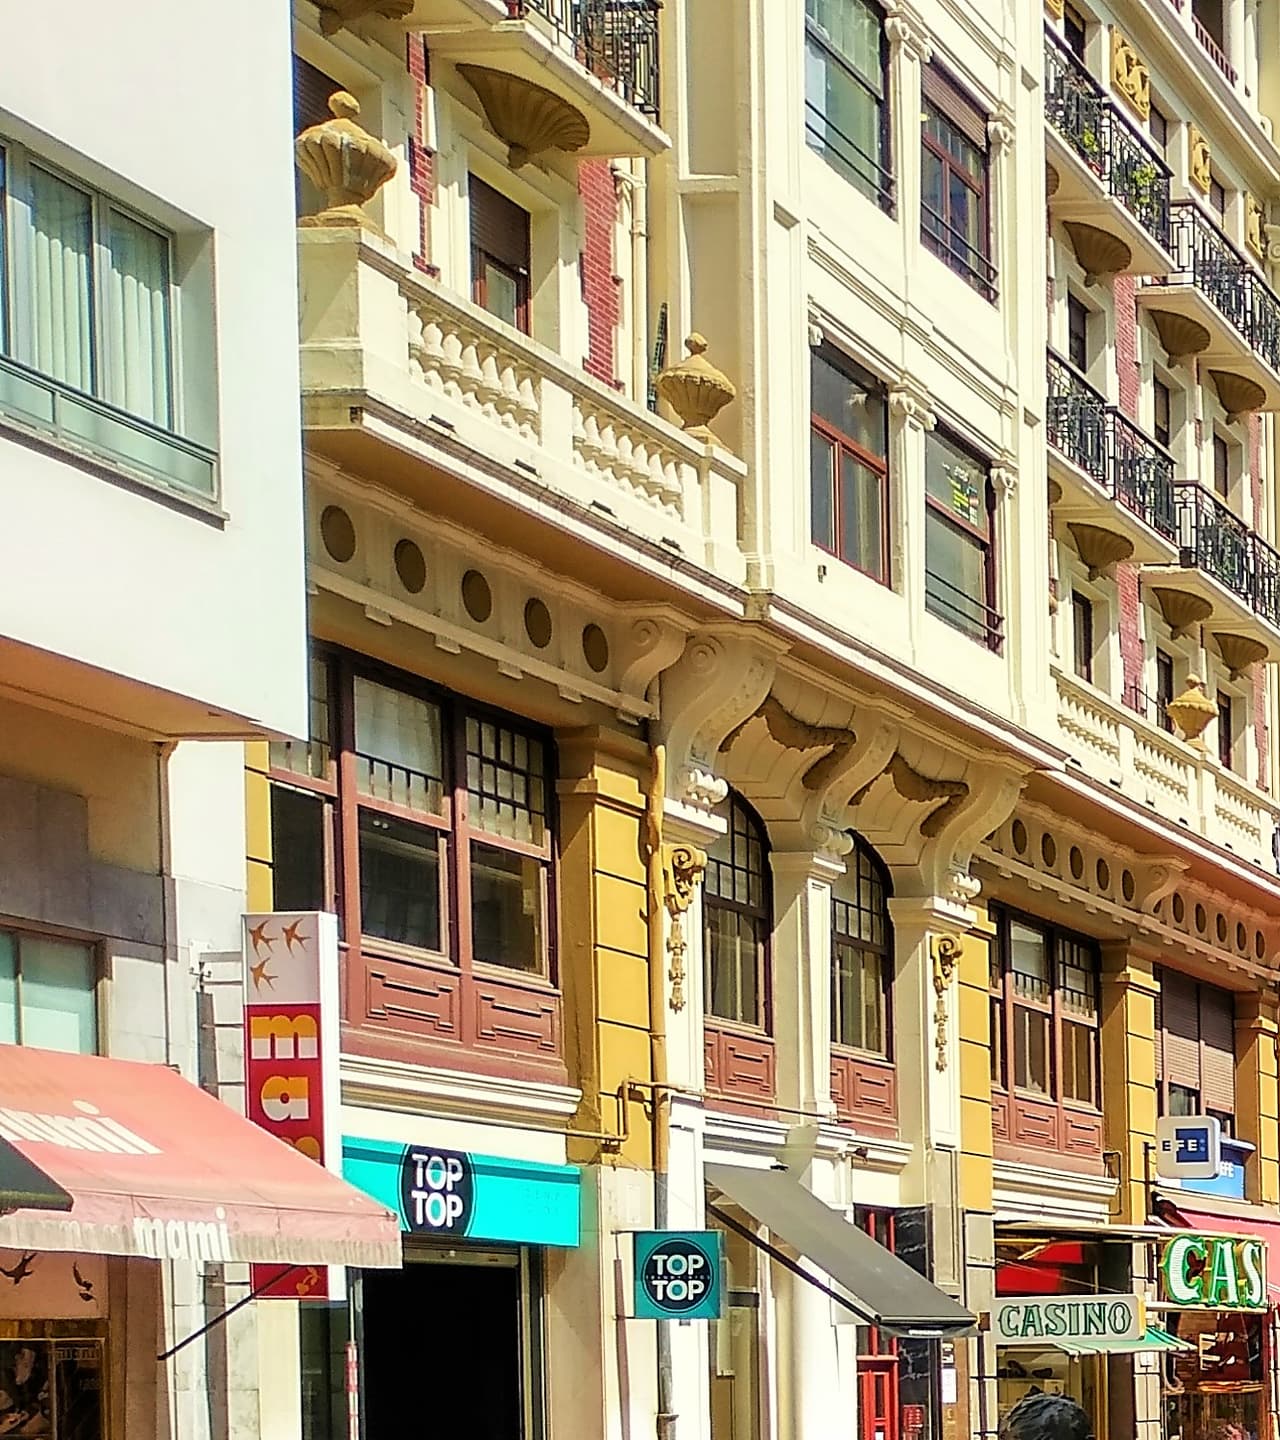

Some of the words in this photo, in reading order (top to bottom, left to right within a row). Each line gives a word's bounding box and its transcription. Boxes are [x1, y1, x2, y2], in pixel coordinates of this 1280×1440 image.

[411, 1153, 464, 1192] TOP
[411, 1190, 464, 1228] TOP
[134, 1206, 232, 1262] mami
[651, 1254, 704, 1276] TOP
[651, 1279, 704, 1301] TOP
[997, 1301, 1132, 1337] CASINO
